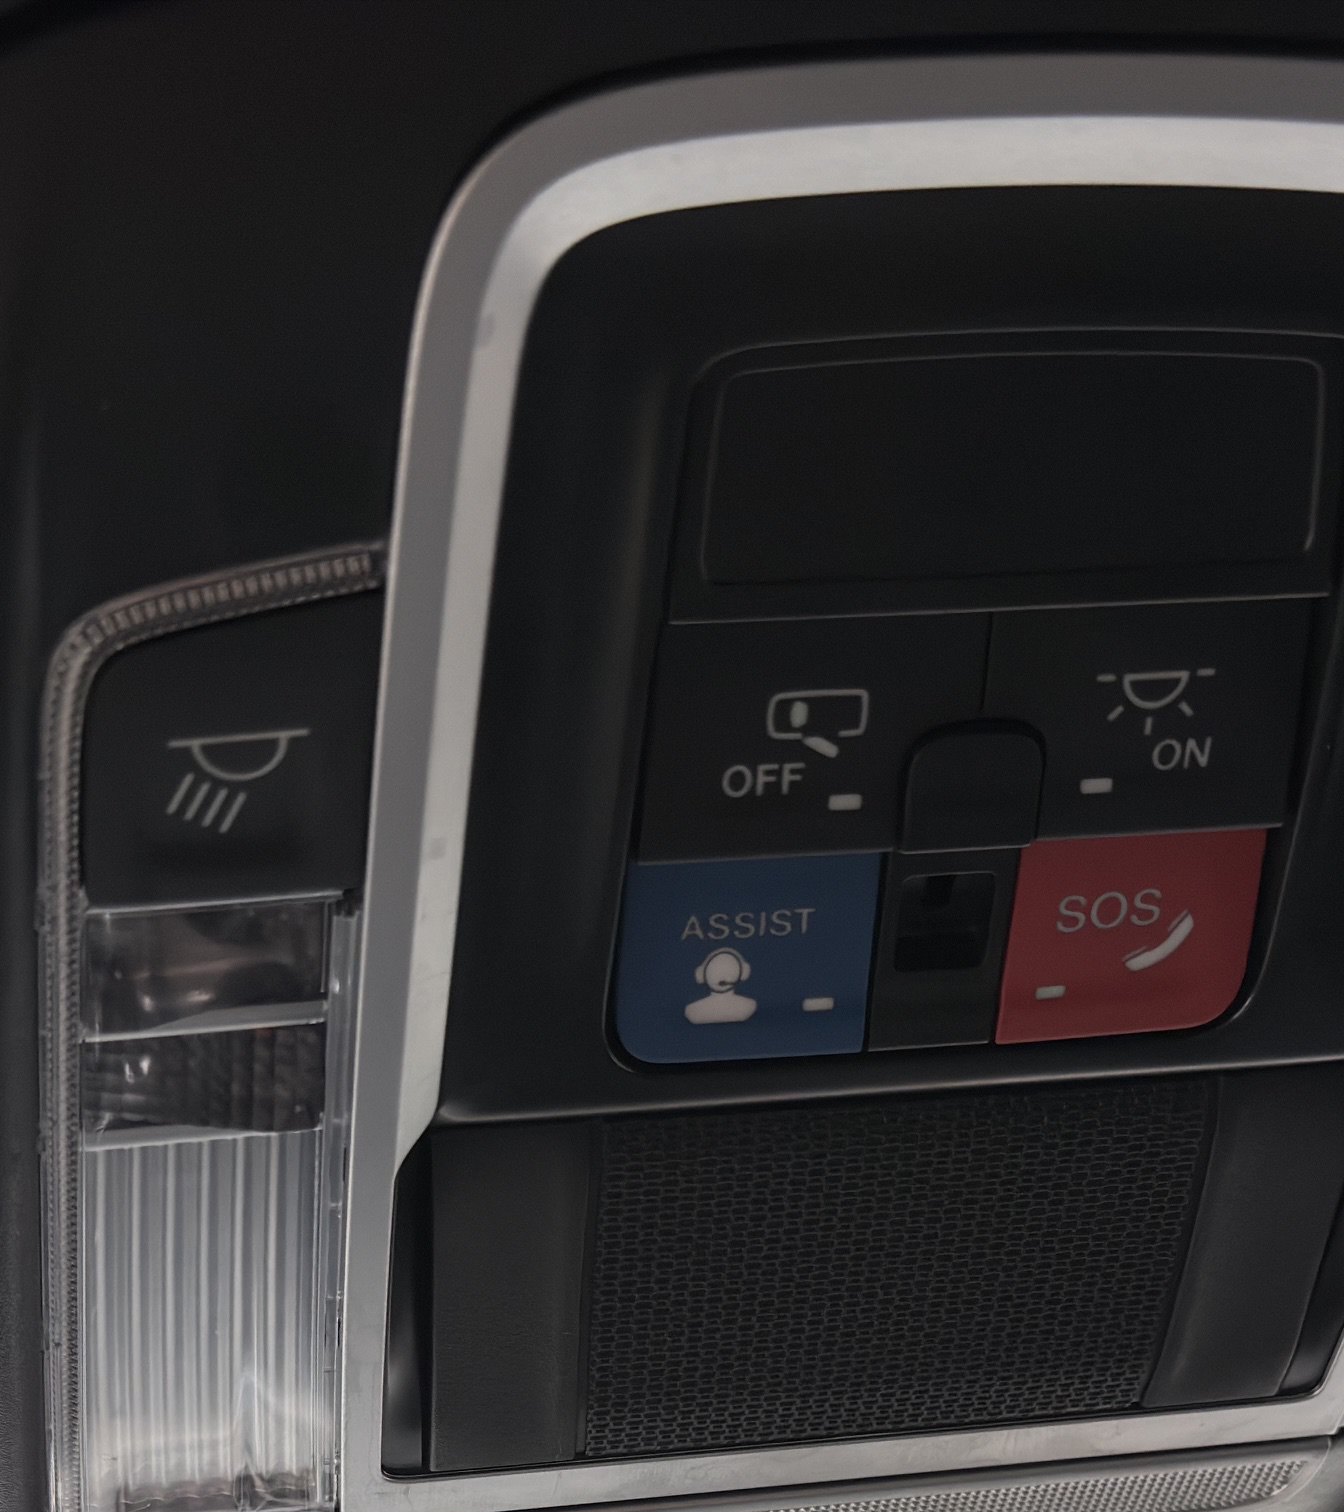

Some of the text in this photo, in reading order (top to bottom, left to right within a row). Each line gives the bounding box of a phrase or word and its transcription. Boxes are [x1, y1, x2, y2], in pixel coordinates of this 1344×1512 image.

[1151, 736, 1213, 772] ON
[721, 762, 806, 799] OFF
[681, 907, 816, 941] ASSIST
[1056, 887, 1163, 934] SOS
